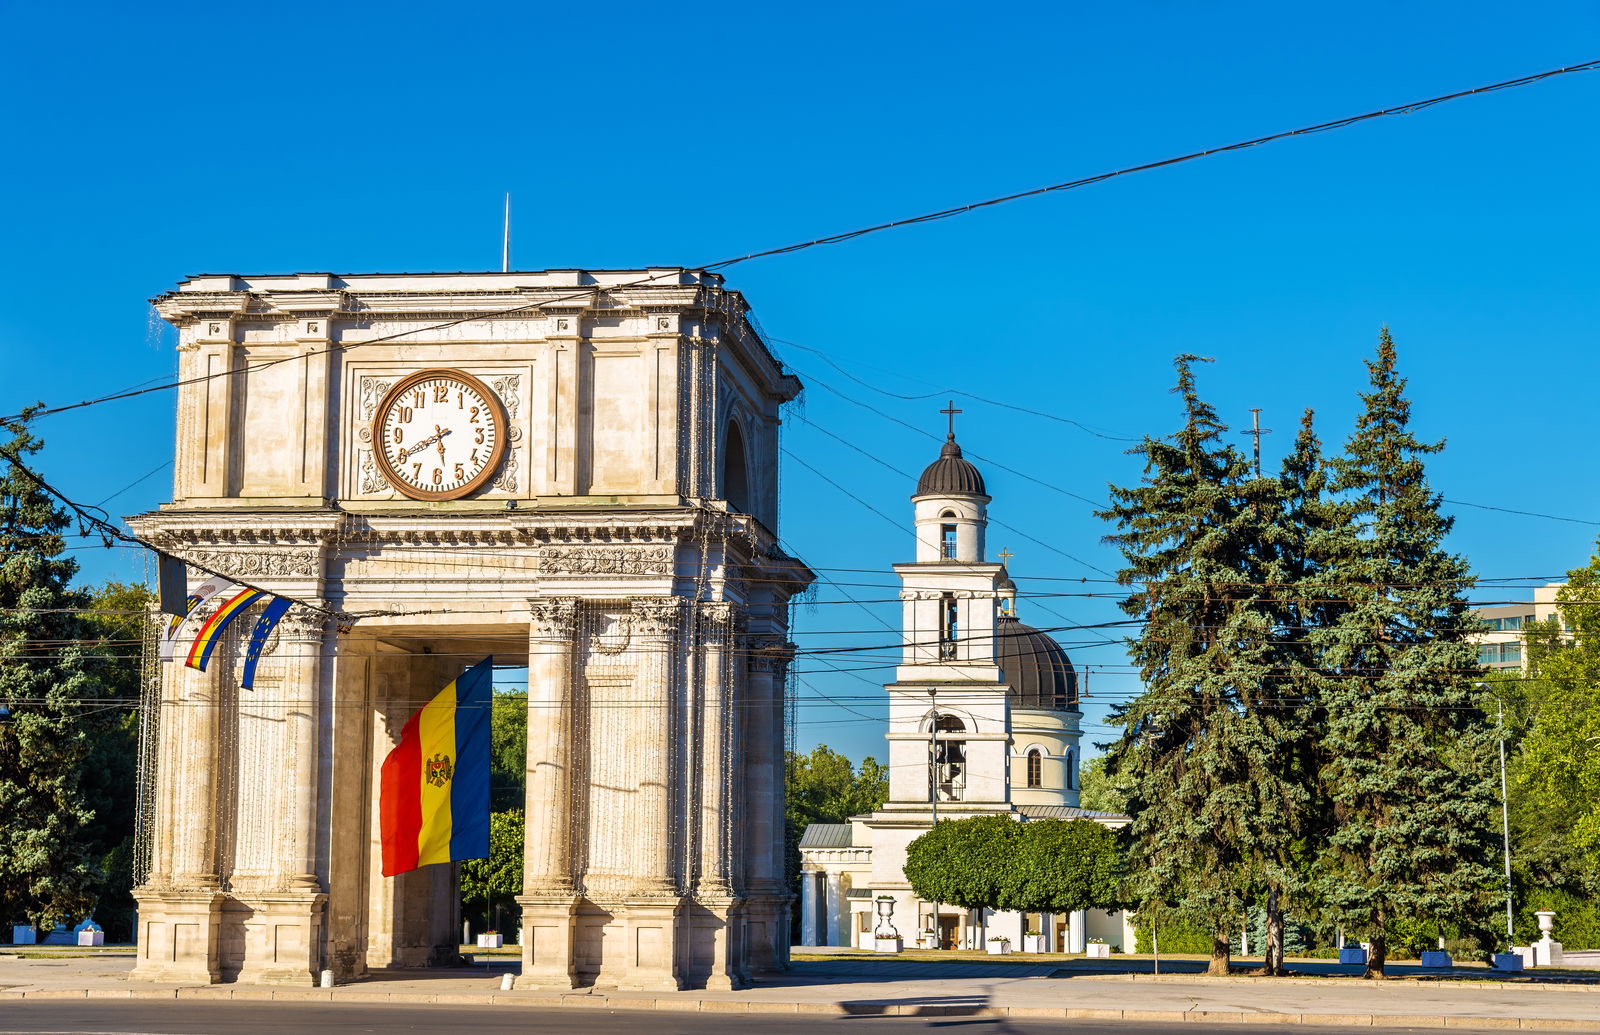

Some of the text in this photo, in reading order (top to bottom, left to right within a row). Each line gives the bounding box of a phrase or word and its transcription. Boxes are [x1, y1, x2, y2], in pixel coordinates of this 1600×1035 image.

[413, 391, 425, 408] 11
[433, 386, 448, 403] 12
[457, 392, 463, 409] 1
[397, 406, 412, 423] 10
[470, 406, 479, 423] 2
[393, 427, 403, 444] 9
[475, 427, 484, 444] 3
[397, 448, 407, 464] 8
[470, 448, 479, 465] 4
[413, 463, 422, 480] 7
[432, 468, 442, 485] 6
[454, 463, 464, 480] 5
